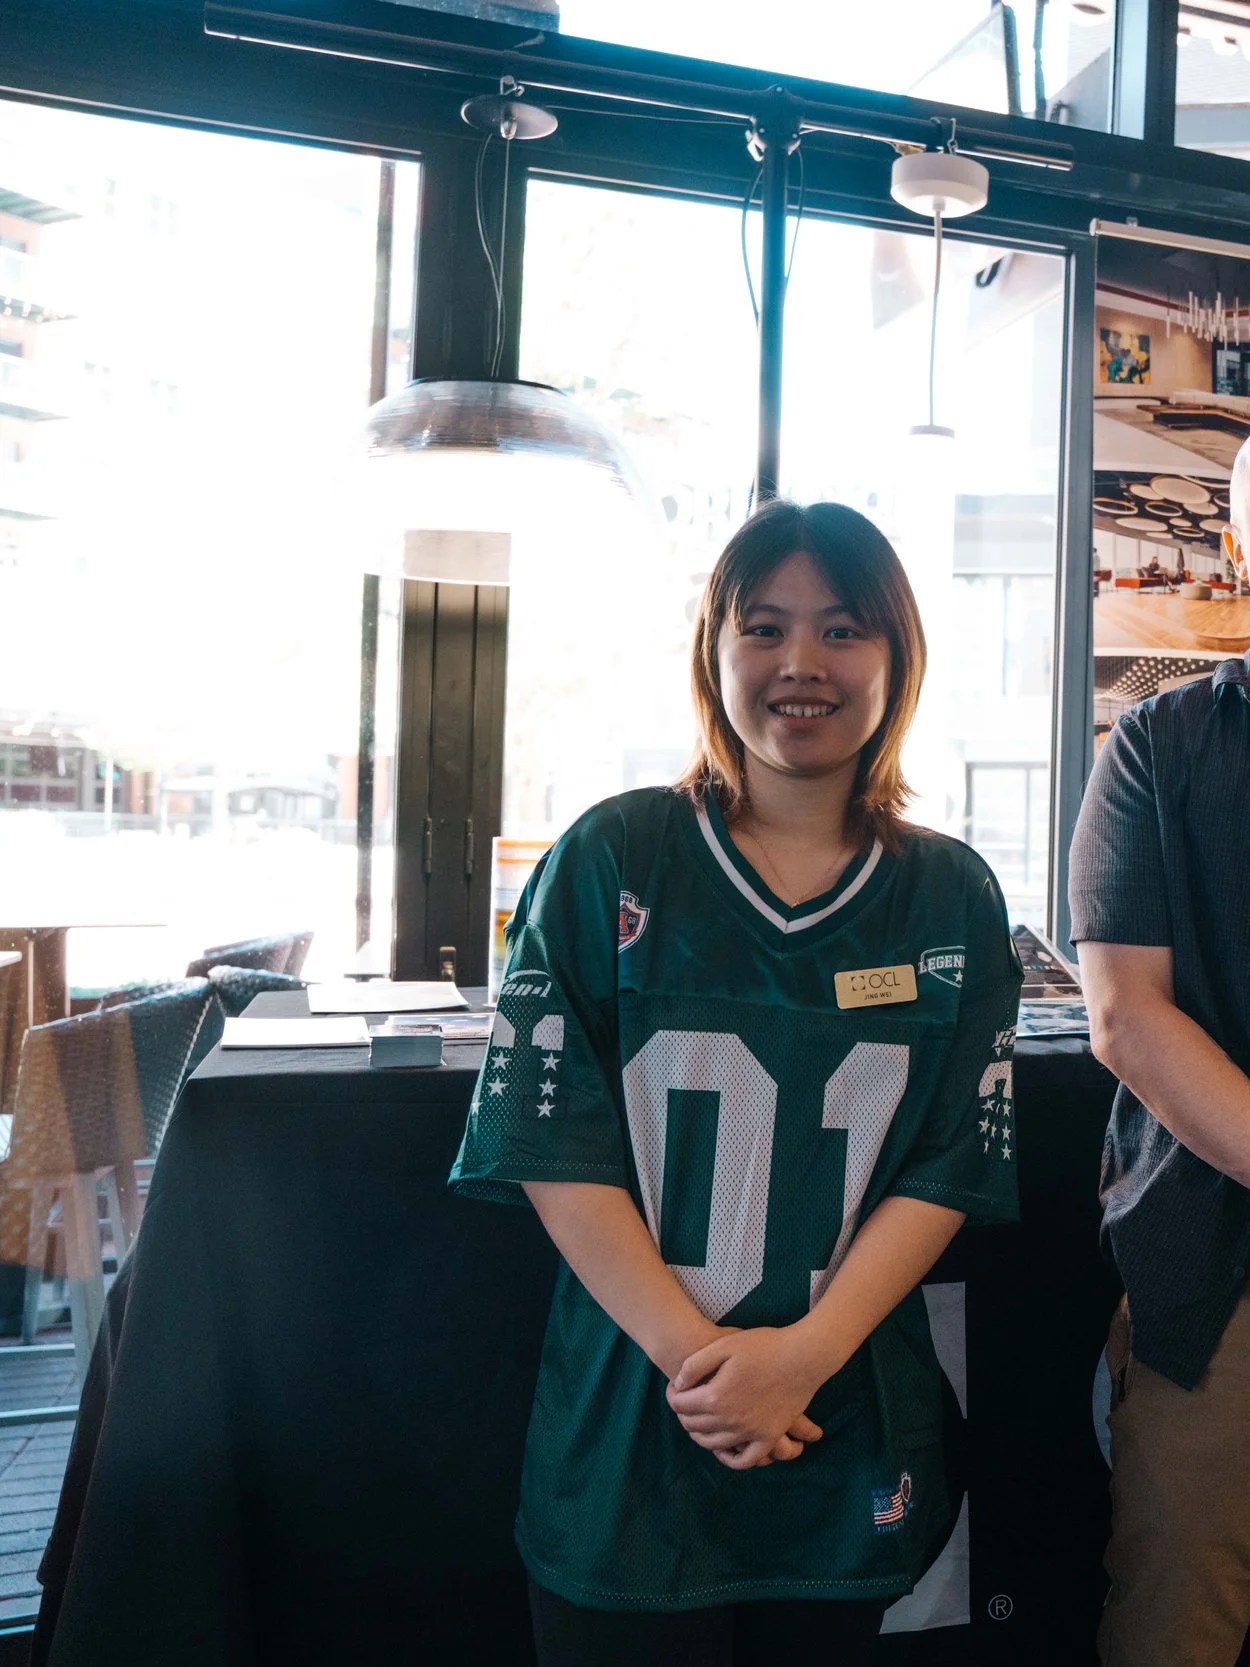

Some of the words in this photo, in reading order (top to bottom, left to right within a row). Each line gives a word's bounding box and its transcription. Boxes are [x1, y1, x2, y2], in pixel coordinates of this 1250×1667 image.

[869, 971, 901, 989] OCL
[880, 991, 892, 999] WEI
[622, 1030, 910, 1323] 01
